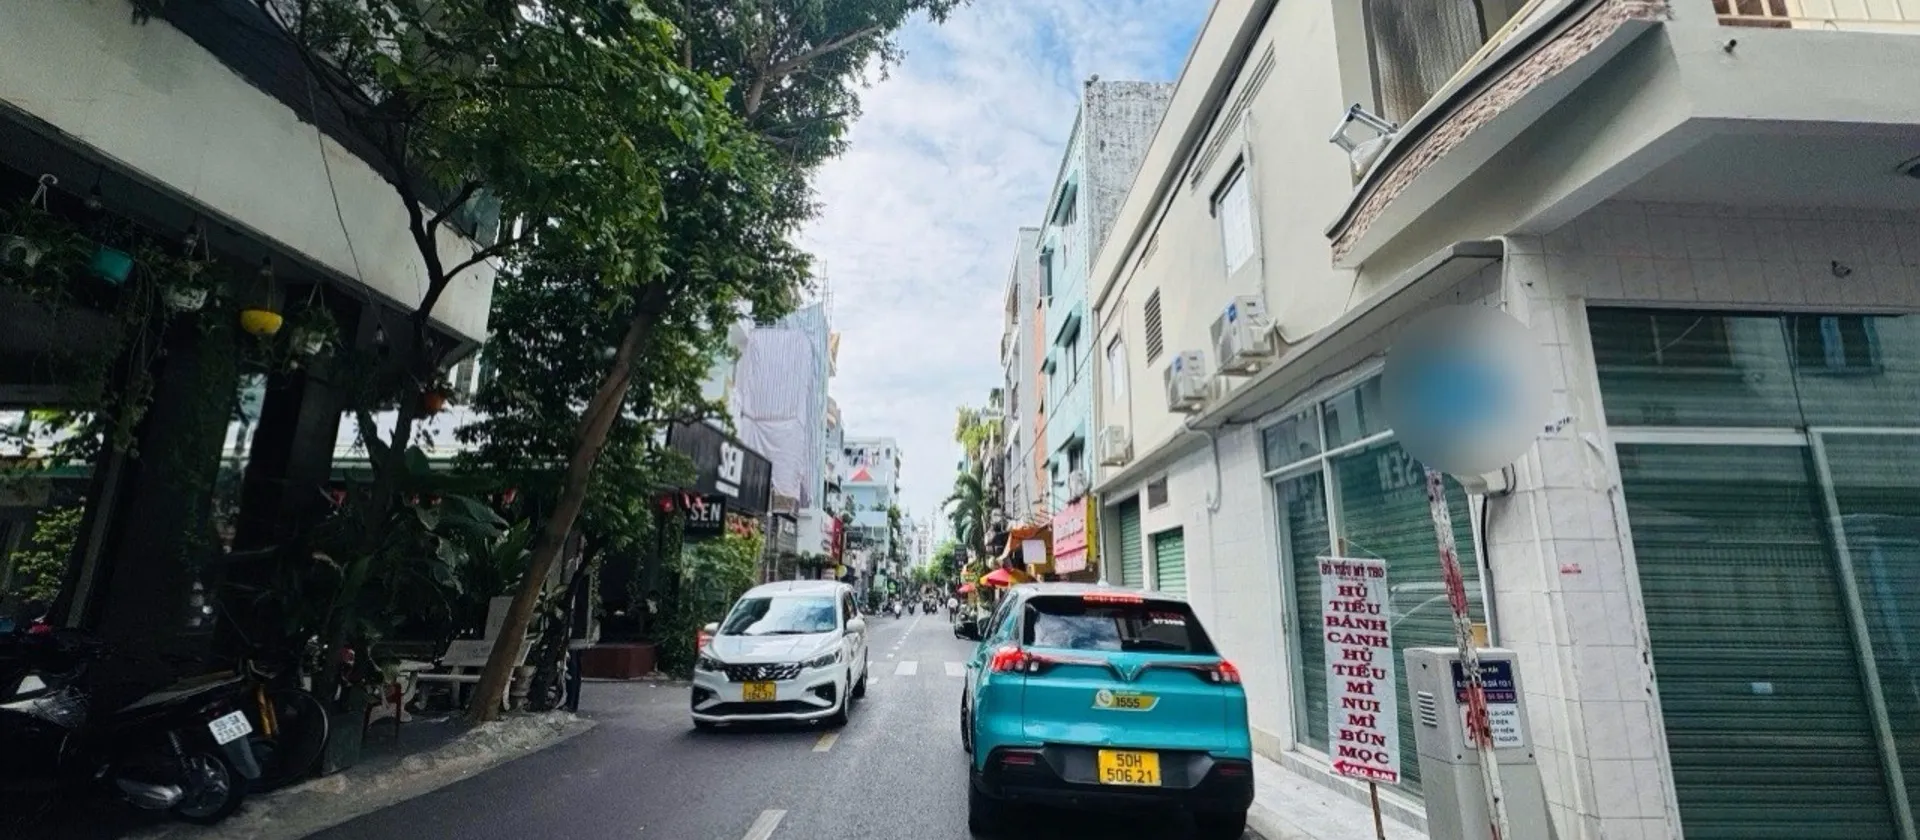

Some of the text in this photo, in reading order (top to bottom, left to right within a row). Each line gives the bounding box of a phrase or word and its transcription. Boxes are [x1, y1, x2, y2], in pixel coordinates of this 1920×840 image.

[690, 503, 721, 521] SEN
[1338, 583, 1368, 597] HỦ
[1329, 599, 1381, 615] TIẾU
[1326, 615, 1387, 632] BÁNH
[1327, 632, 1389, 648] CANH
[1342, 647, 1373, 662] HỦ
[1332, 663, 1386, 680] TIẾU
[1346, 681, 1374, 695] MÌ
[1115, 696, 1141, 709] 1555
[1341, 697, 1381, 713] NUI
[1348, 714, 1376, 729] MÌ
[1340, 729, 1386, 747] BÚN
[1116, 754, 1142, 767] 50H
[1338, 745, 1389, 764] MỌC
[1107, 768, 1153, 783] 506.21
